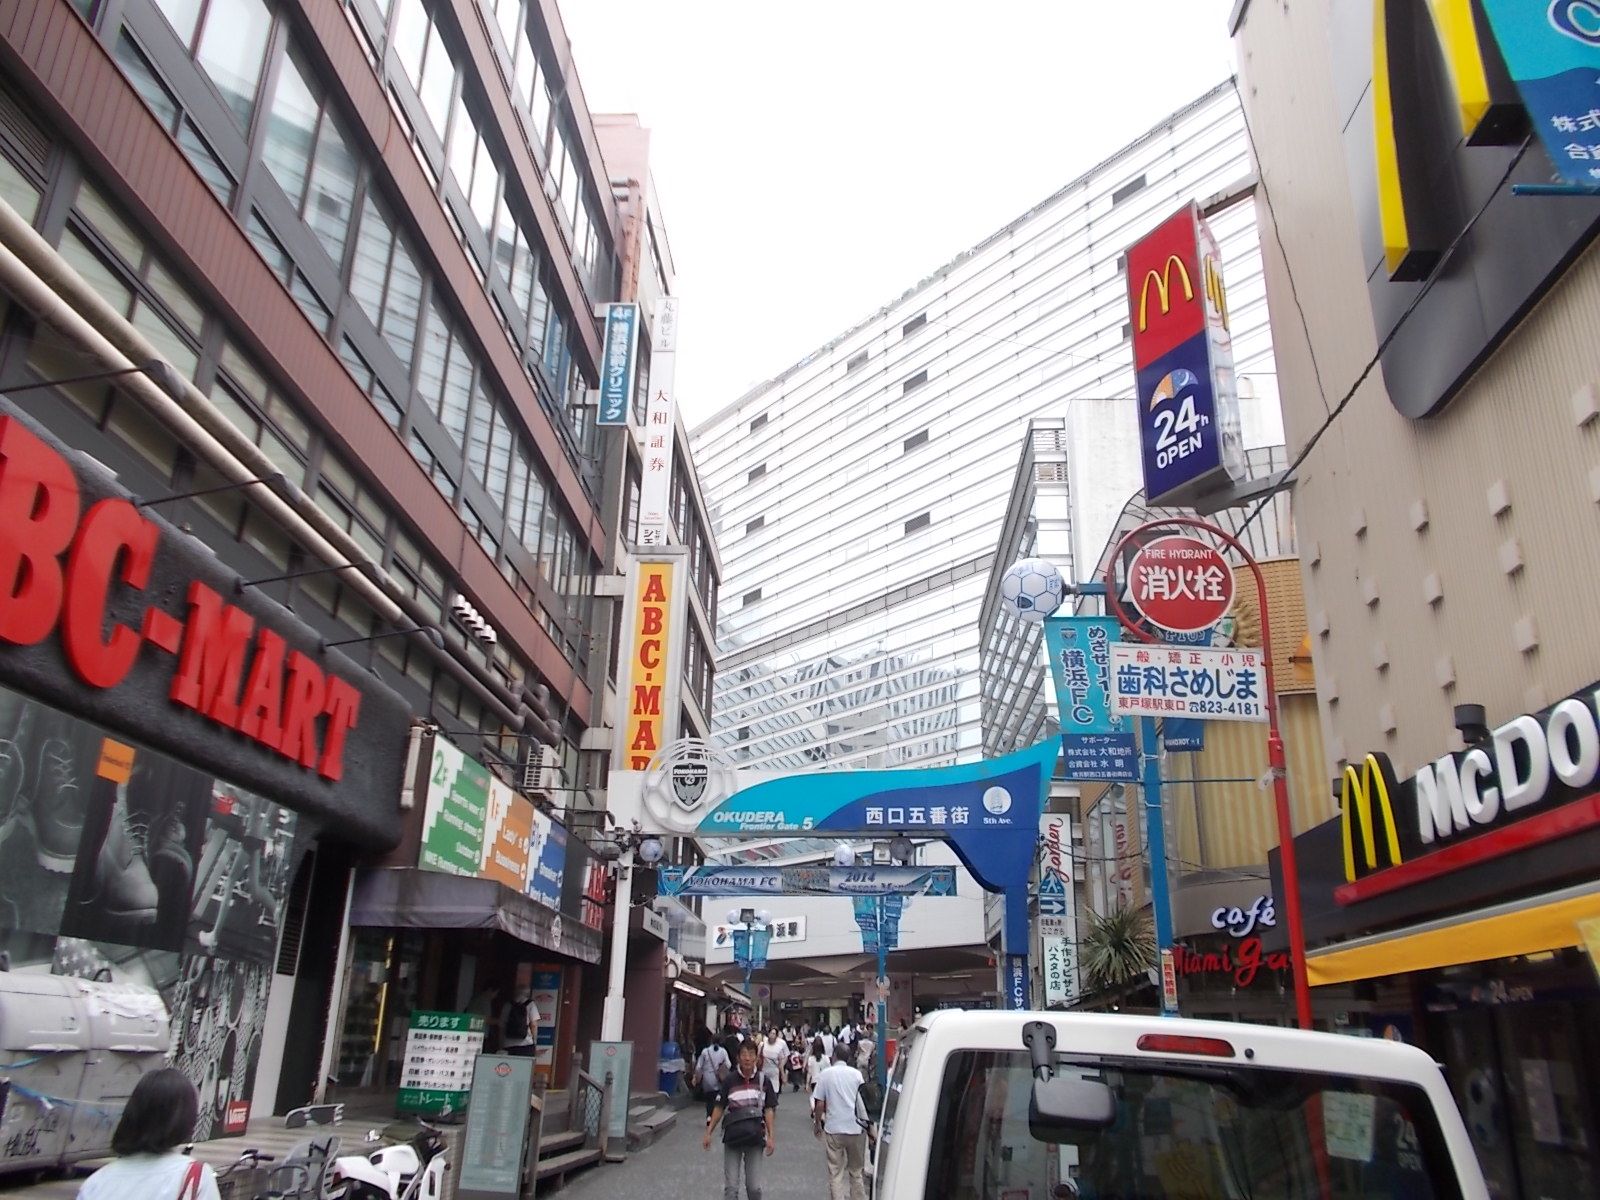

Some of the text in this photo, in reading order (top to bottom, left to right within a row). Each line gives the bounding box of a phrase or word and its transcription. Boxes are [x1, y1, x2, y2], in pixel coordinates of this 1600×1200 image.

[648, 389, 668, 472] 大和証券
[1156, 431, 1202, 470] OPEN
[1146, 549, 1214, 560] FIRE HYDRANT
[1139, 565, 1226, 601] 消火栓
[1061, 648, 1095, 725] 横浜FC
[1116, 663, 1259, 700] 歯科さめじま
[1118, 697, 1186, 712] 東戸塚駅東口
[1081, 736, 1118, 745] サポーター
[1067, 746, 1132, 757] 株式会社 大和地所
[713, 811, 785, 823] OKUDERA
[865, 806, 970, 825] 西口五番街
[983, 816, 1013, 825] 5th Ave.
[739, 821, 799, 831] Frontier Gate
[801, 816, 814, 830] 5
[689, 876, 777, 887] YOKOHAMA FC
[845, 872, 876, 882] 2014
[1211, 896, 1277, 937] café
[1049, 945, 1062, 991] パスタの店
[417, 1015, 460, 1029] 売ります
